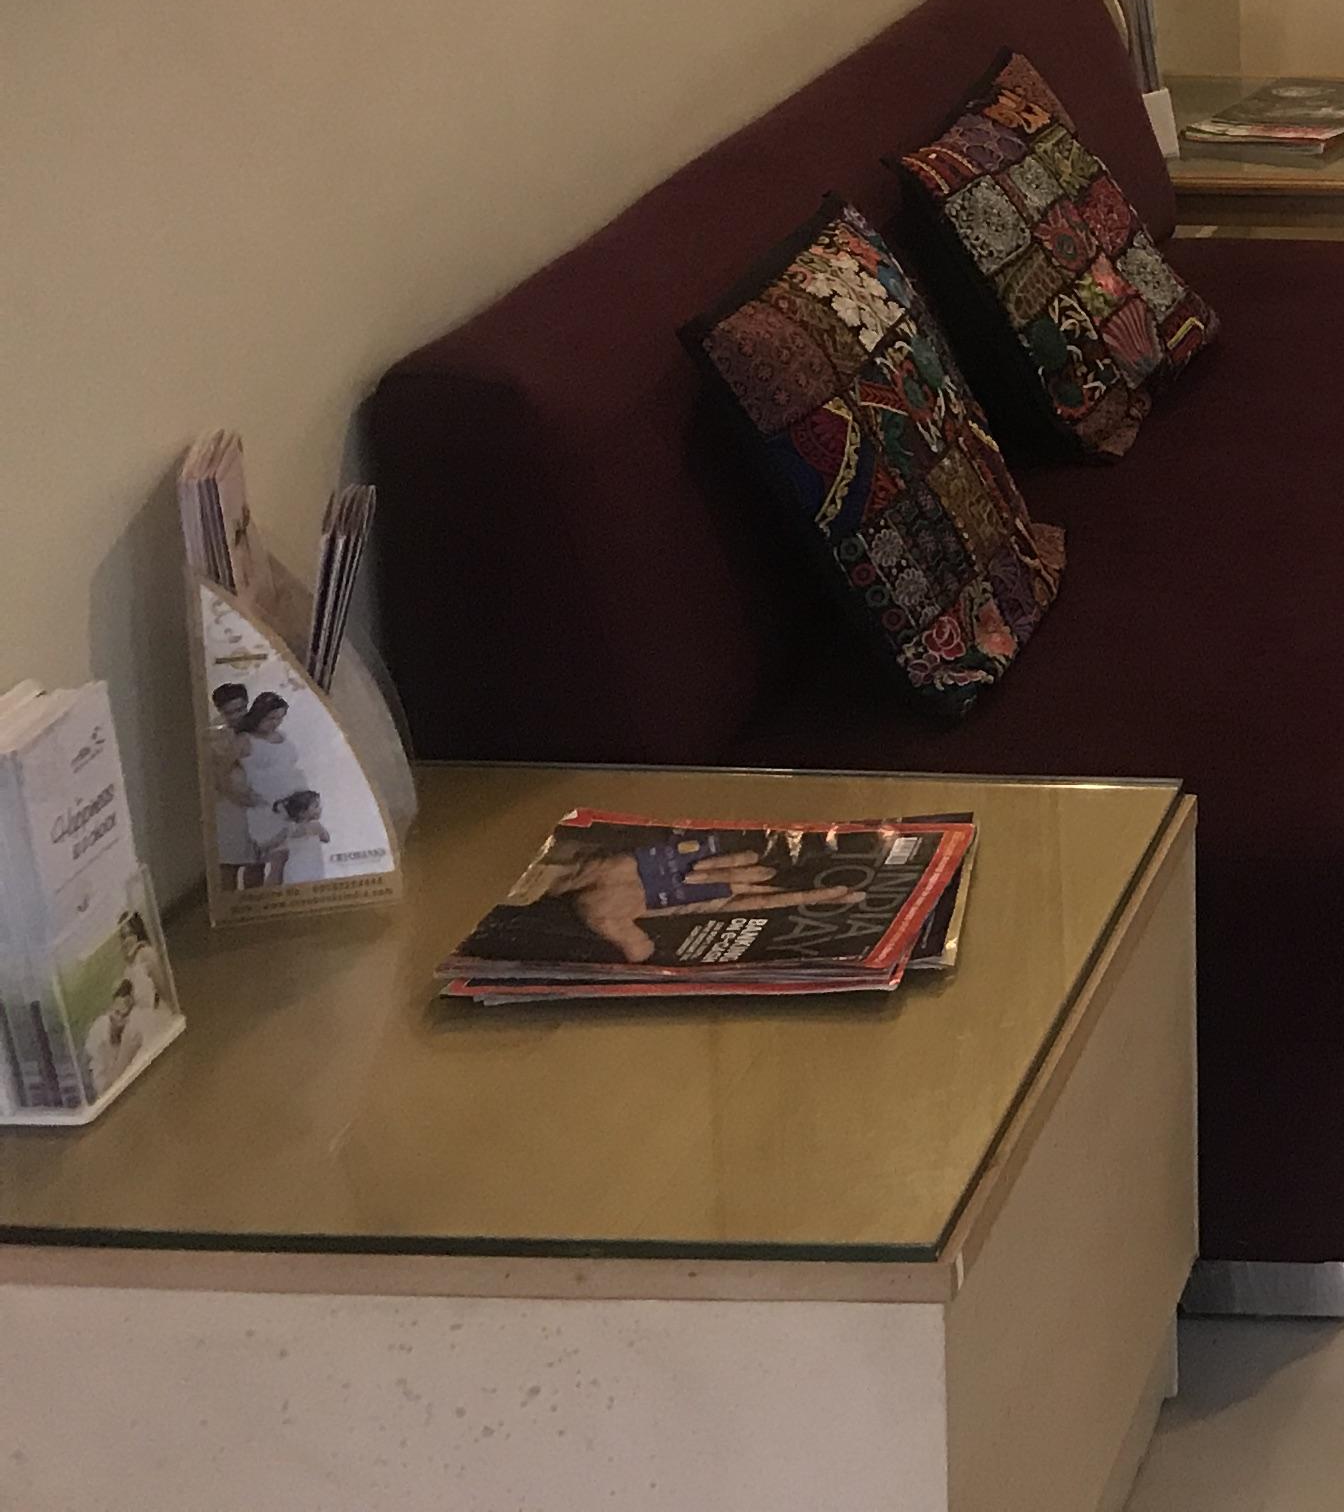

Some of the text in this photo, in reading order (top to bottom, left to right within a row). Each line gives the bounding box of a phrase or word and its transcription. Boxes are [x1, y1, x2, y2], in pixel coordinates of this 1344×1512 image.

[726, 918, 747, 931] ON
[766, 839, 888, 955] TODAY
[842, 864, 924, 939] INDIA
[718, 918, 769, 963] BANKING
